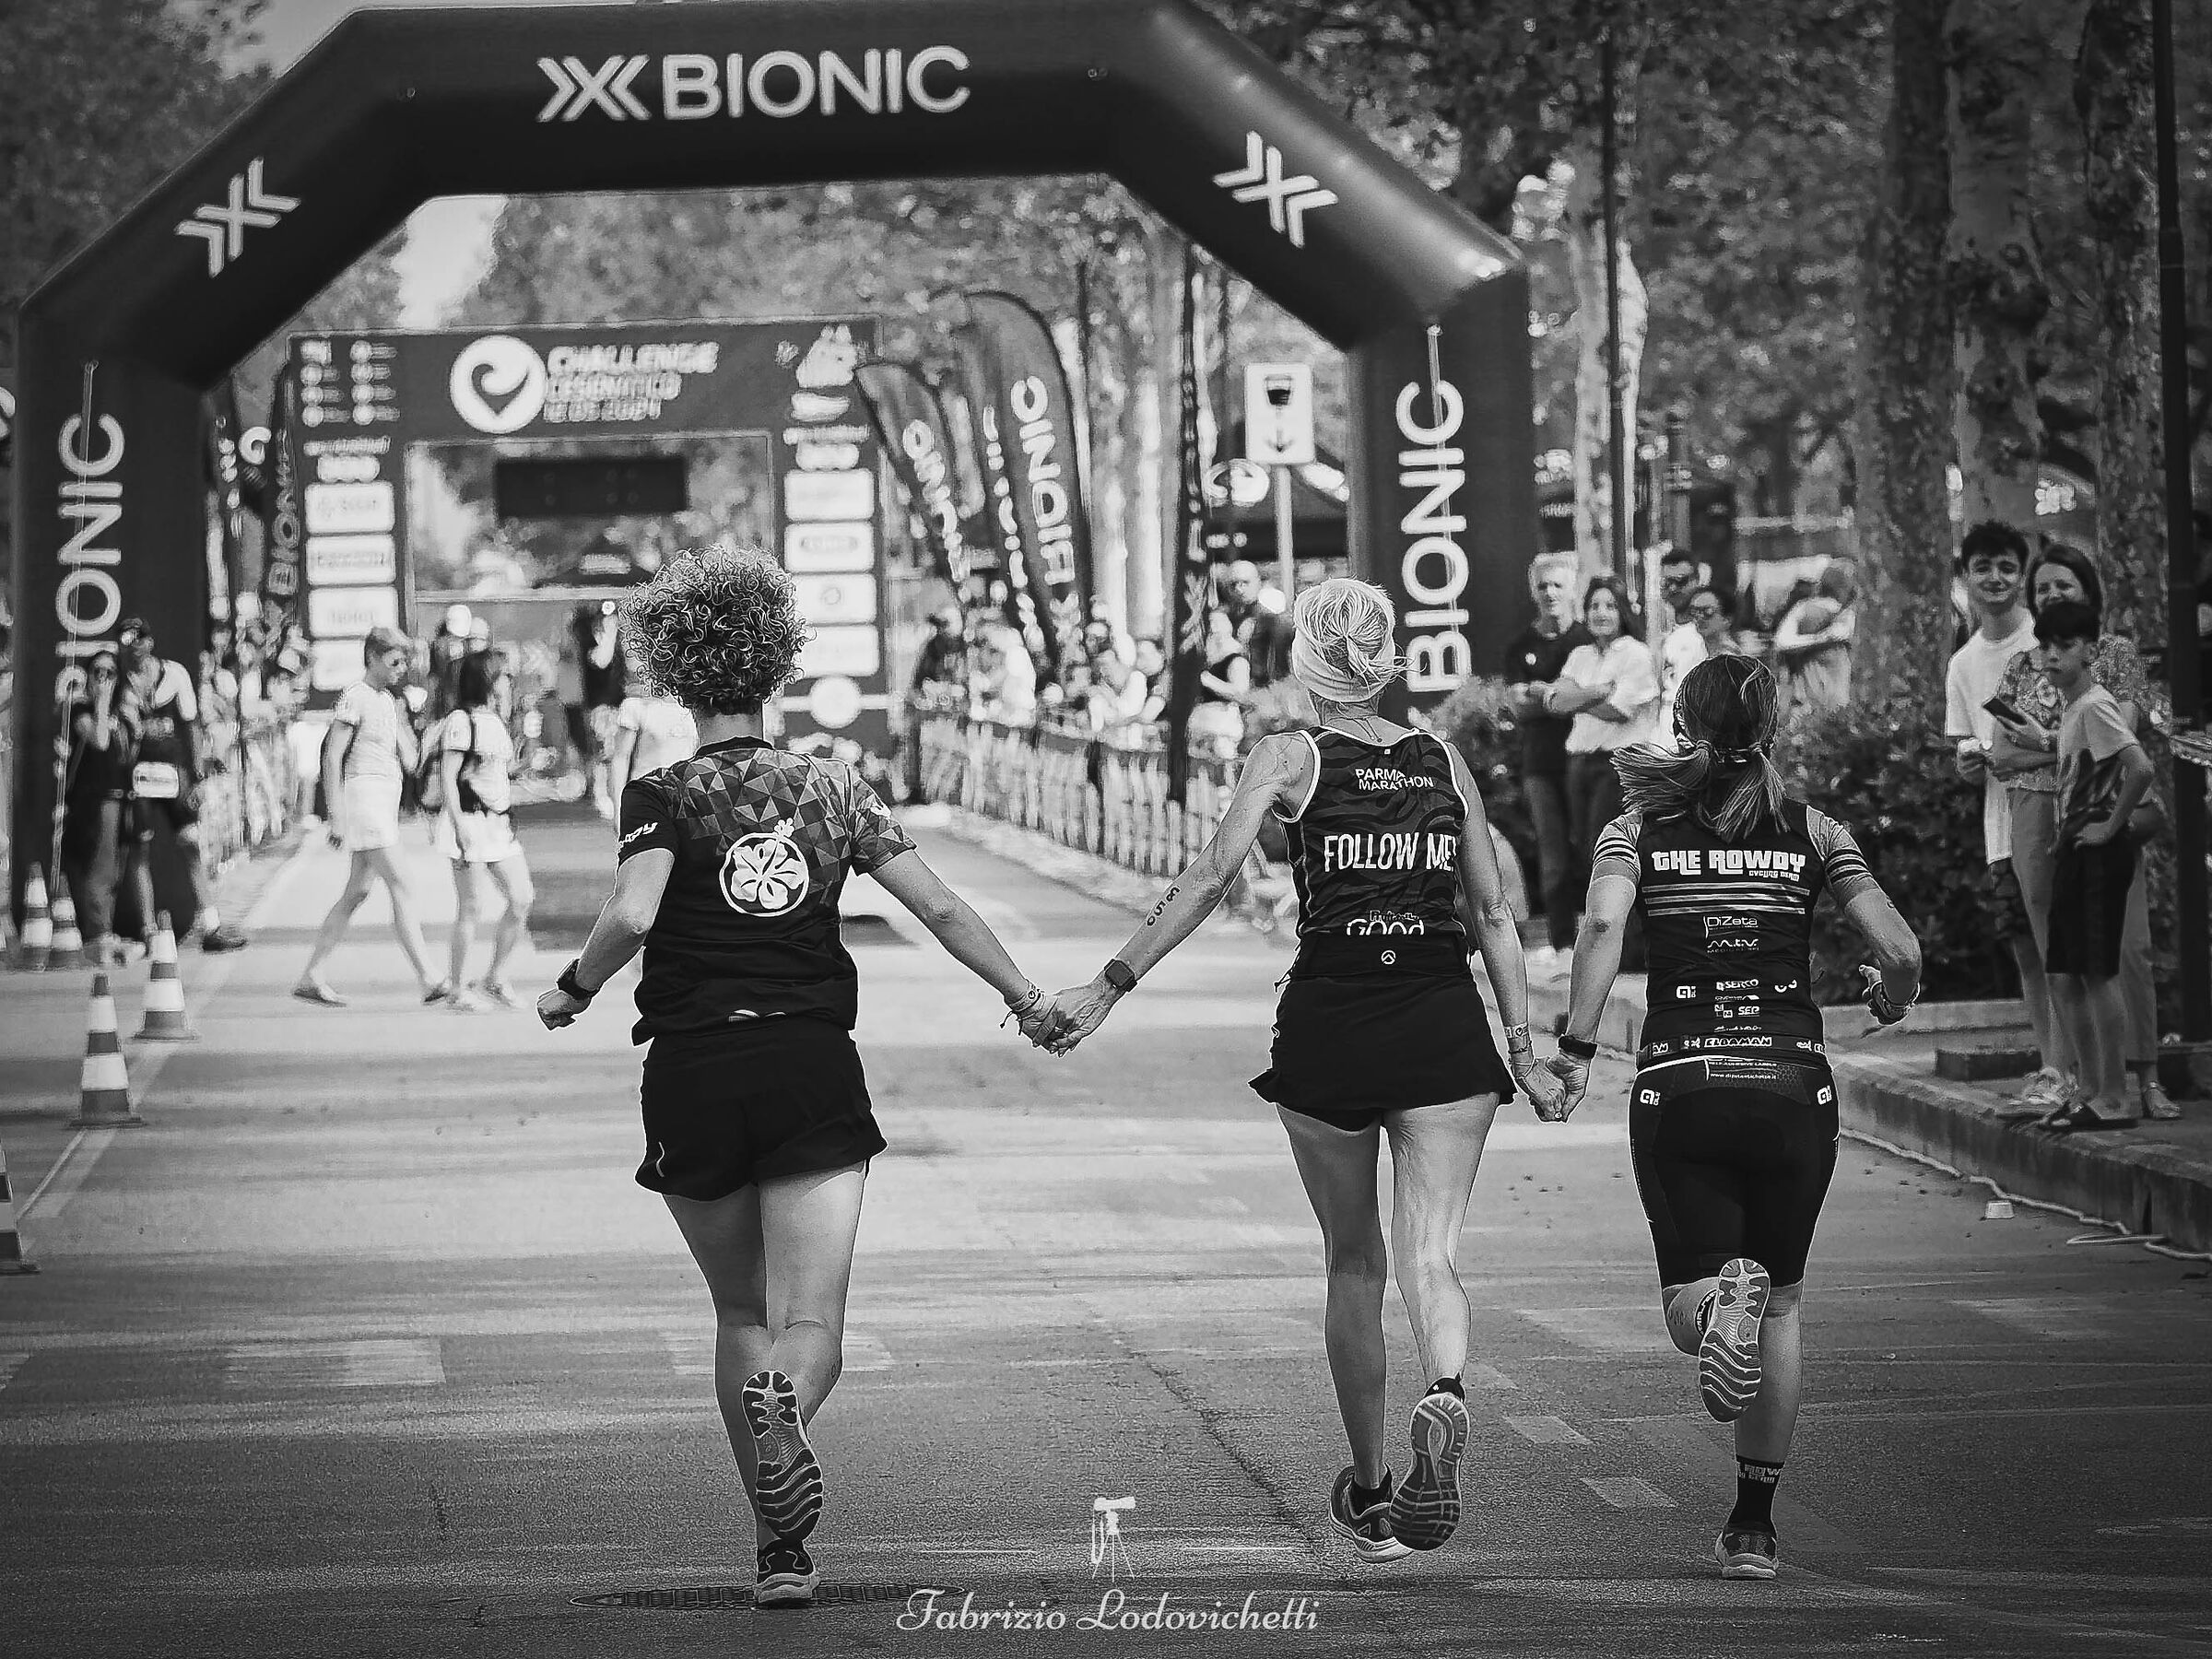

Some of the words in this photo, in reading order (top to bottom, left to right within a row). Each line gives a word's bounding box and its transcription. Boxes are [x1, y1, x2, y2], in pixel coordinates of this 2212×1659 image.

[663, 44, 971, 120] BIONIC
[1395, 379, 1473, 692] BIONIC
[1355, 768, 1406, 782] PARMA
[1359, 776, 1434, 791] MARATHON
[1324, 832, 1419, 872] FOLLOW
[1652, 850, 1701, 875] THE
[1708, 850, 1806, 875] ROWDY
[1707, 916, 1758, 927] DiZeta
[1724, 979, 1759, 989] SERCO
